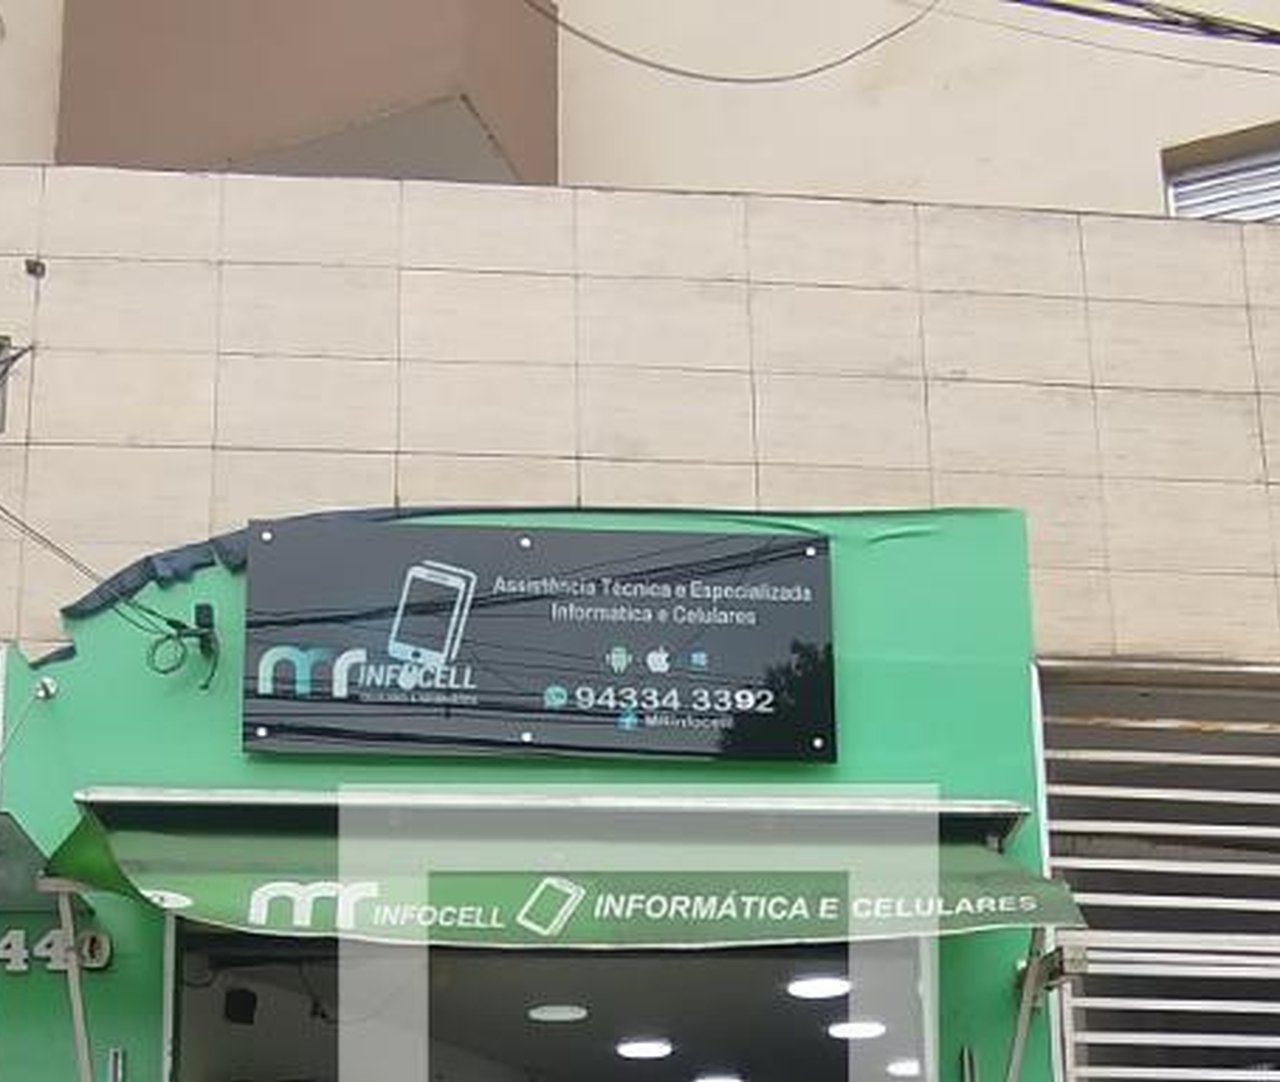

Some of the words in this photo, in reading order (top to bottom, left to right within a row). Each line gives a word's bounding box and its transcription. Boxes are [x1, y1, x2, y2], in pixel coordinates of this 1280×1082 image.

[675, 583, 686, 599] e
[690, 580, 813, 603] Especializada
[657, 609, 669, 623] e
[673, 605, 757, 625] Celulares
[575, 686, 681, 710] 94334
[691, 688, 775, 713] 3392
[373, 904, 507, 929] INFOCELL
[594, 889, 810, 920] INFORMÁTICA
[819, 901, 839, 919] E
[852, 893, 1038, 919] CELULARES
